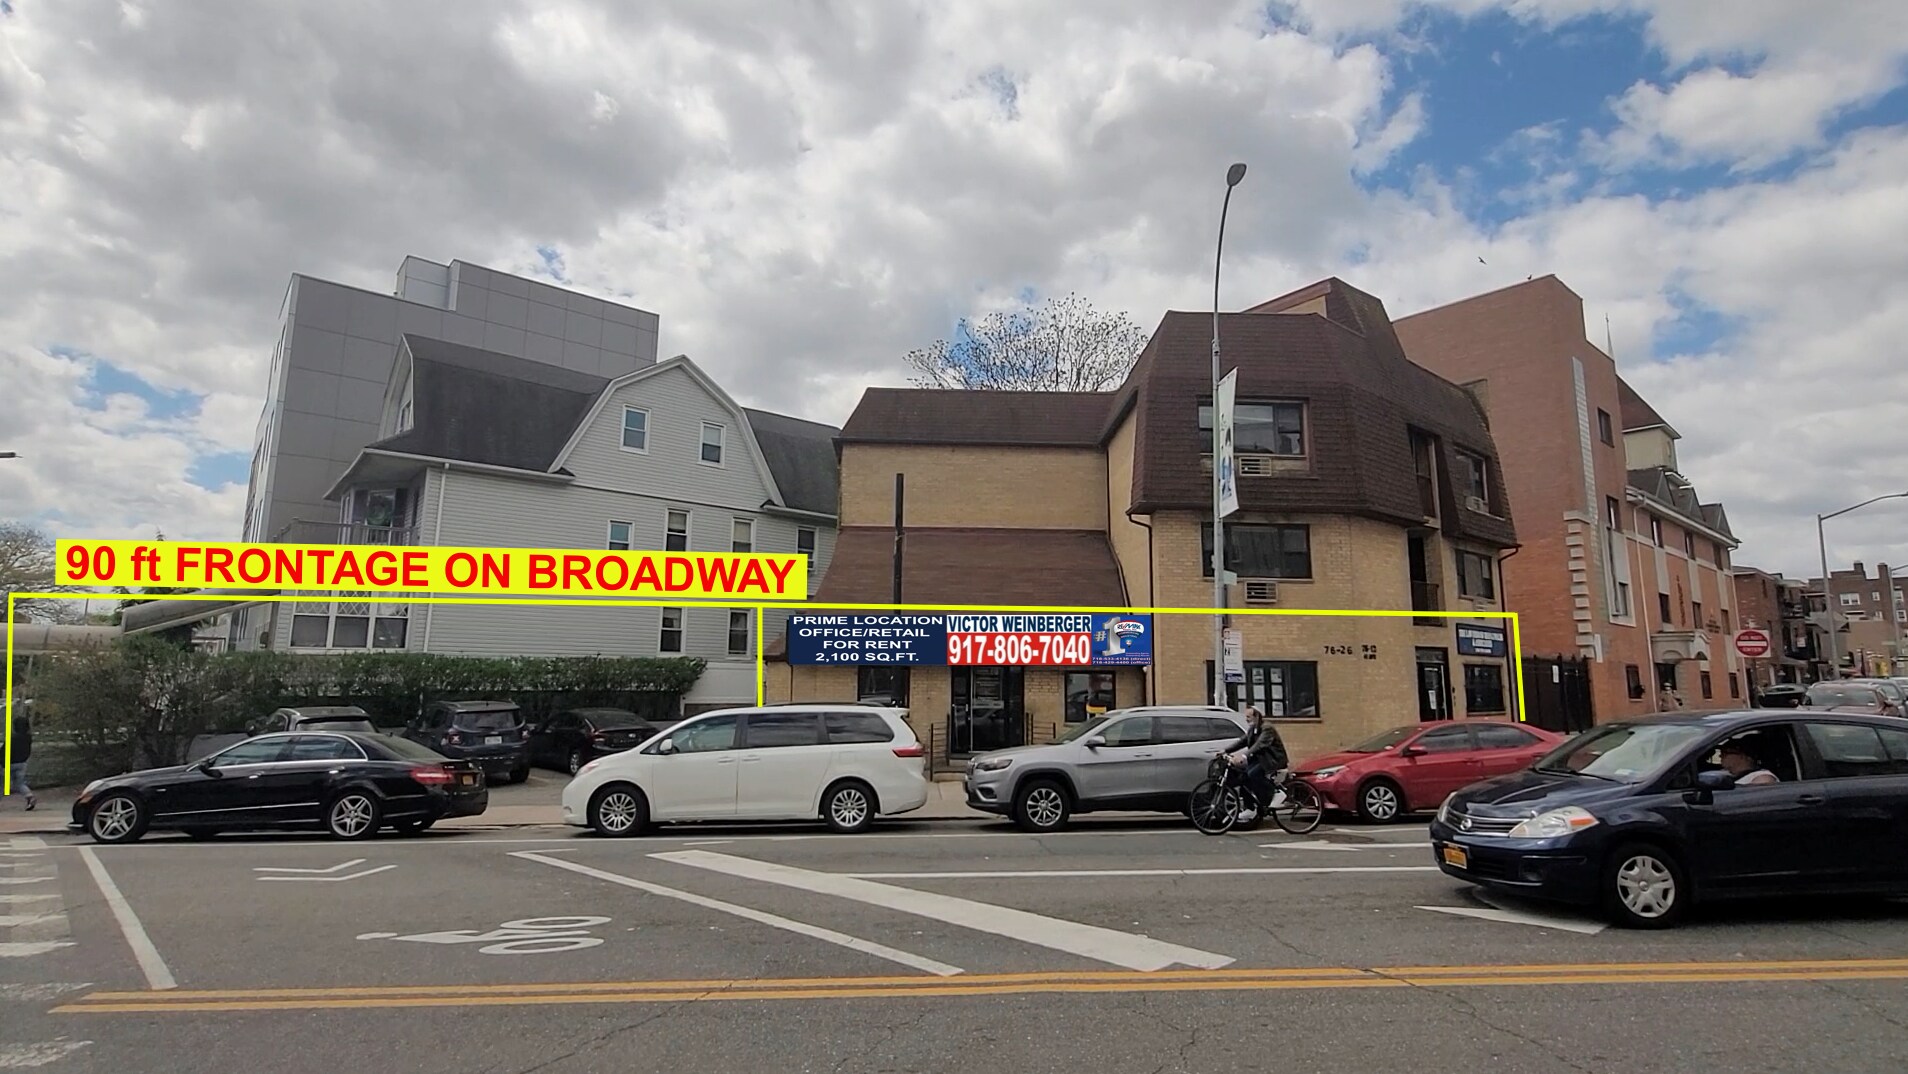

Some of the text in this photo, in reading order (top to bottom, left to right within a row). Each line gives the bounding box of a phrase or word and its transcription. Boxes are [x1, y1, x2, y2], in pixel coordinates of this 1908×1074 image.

[793, 616, 943, 625] PRIME LOCATION
[948, 616, 1091, 632] VICTOR WEINBERGER
[798, 628, 930, 637] OFFICE/RETAIL
[823, 640, 913, 649] FOR RENT
[948, 634, 1091, 664] 917-806-7040
[1324, 646, 1353, 655] 76-26
[815, 652, 919, 662] 2,100 SQ.FT.
